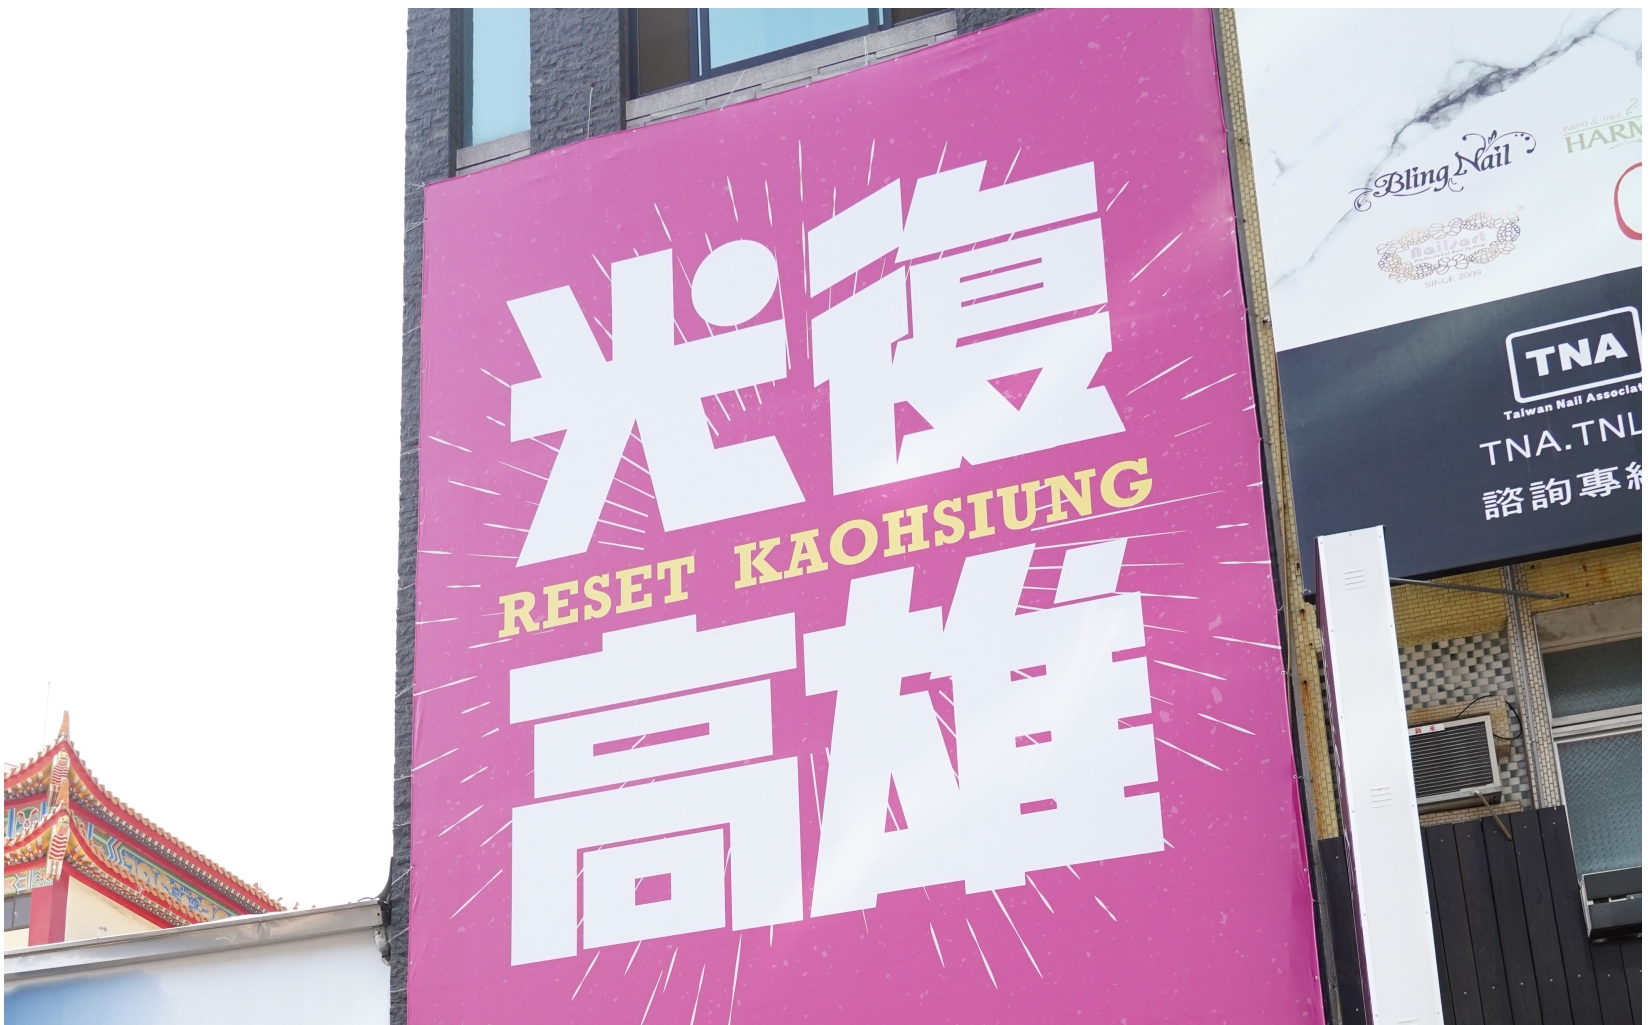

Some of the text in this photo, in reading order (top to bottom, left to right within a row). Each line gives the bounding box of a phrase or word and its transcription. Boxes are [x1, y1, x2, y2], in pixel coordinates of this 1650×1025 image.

[1563, 120, 1588, 133] hand
[1602, 112, 1621, 122] nail
[1373, 142, 1513, 198] Bling Nail
[1424, 269, 1483, 289] SINCE 2009
[507, 159, 1127, 567] 光復
[1524, 331, 1629, 377] TNA
[1503, 403, 1554, 421] Taiwan
[1556, 394, 1584, 411] Nail
[497, 457, 1154, 639] RESET KAOHSIUNG
[509, 536, 1165, 967] 高雄
